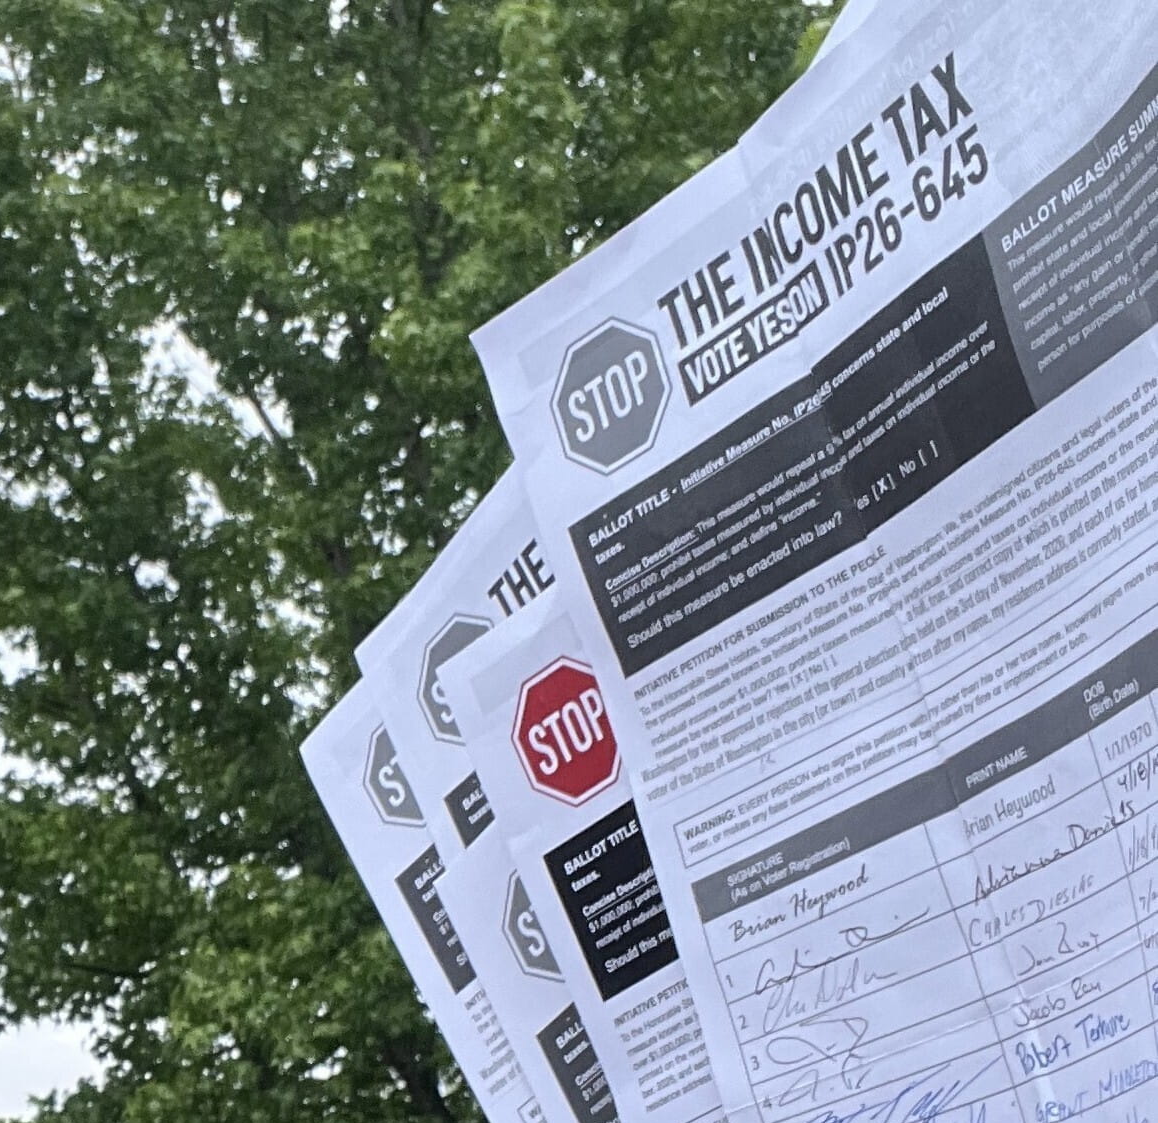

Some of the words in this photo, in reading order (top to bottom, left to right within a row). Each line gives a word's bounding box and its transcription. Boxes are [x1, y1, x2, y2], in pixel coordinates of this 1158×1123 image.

[657, 251, 745, 350] THE
[741, 122, 890, 296] INCOME
[880, 51, 974, 166] TAX
[1000, 197, 1059, 253] BALLOT
[1060, 133, 1129, 206] MEASURE
[1087, 207, 1112, 233] local
[684, 328, 750, 396] VOTE
[824, 123, 989, 298] IP26-645
[568, 350, 649, 443] STOP
[591, 507, 637, 548] BALLOT
[636, 486, 672, 518] TITLE
[678, 453, 726, 490] Initiative
[724, 423, 772, 461] Measure
[772, 412, 795, 432] No.
[832, 348, 875, 387] concerns
[874, 323, 903, 354] state
[900, 306, 922, 333] and
[922, 287, 948, 315] local
[761, 502, 773, 515] by
[981, 340, 995, 356] the
[1062, 434, 1080, 453] and
[605, 563, 641, 590] Concise
[969, 321, 987, 342] over
[594, 538, 626, 565] taxes.
[627, 619, 662, 648] Should
[663, 609, 683, 627] this
[684, 582, 729, 615] measure
[729, 571, 745, 587] be
[747, 542, 791, 577] enacted
[791, 530, 814, 550] into
[815, 511, 842, 537] law?
[899, 460, 916, 477] No
[487, 537, 556, 618] THE
[723, 630, 745, 649] FOR
[746, 594, 809, 635] SUBMISSION
[809, 584, 825, 597] TO
[826, 570, 849, 588] THE
[1083, 680, 1106, 703] DOB
[1088, 696, 1114, 721] (Birth
[1113, 679, 1140, 703] Date)
[528, 688, 604, 776] STOP
[965, 762, 996, 788] PRINT
[996, 746, 1028, 773] NAME
[684, 809, 735, 840] WARNING:
[738, 792, 768, 814] EVERY
[771, 772, 810, 798] PERSON
[994, 774, 1056, 820] Heywood
[563, 838, 608, 876] BALLOT
[606, 819, 640, 848] TITLE
[727, 852, 785, 887] SIGNATURE
[749, 880, 762, 893] on
[761, 866, 788, 888] Voter
[788, 837, 851, 876] Registration)
[582, 890, 616, 917] Concise
[729, 911, 786, 942] Brian
[789, 864, 869, 919] Heywood
[604, 944, 640, 974] Should
[639, 934, 658, 951] this
[726, 975, 733, 988] 1
[738, 1015, 749, 1030] 2
[1014, 994, 1067, 1028] Jacob
[750, 1056, 760, 1071] 3
[762, 1094, 773, 1109] 4
